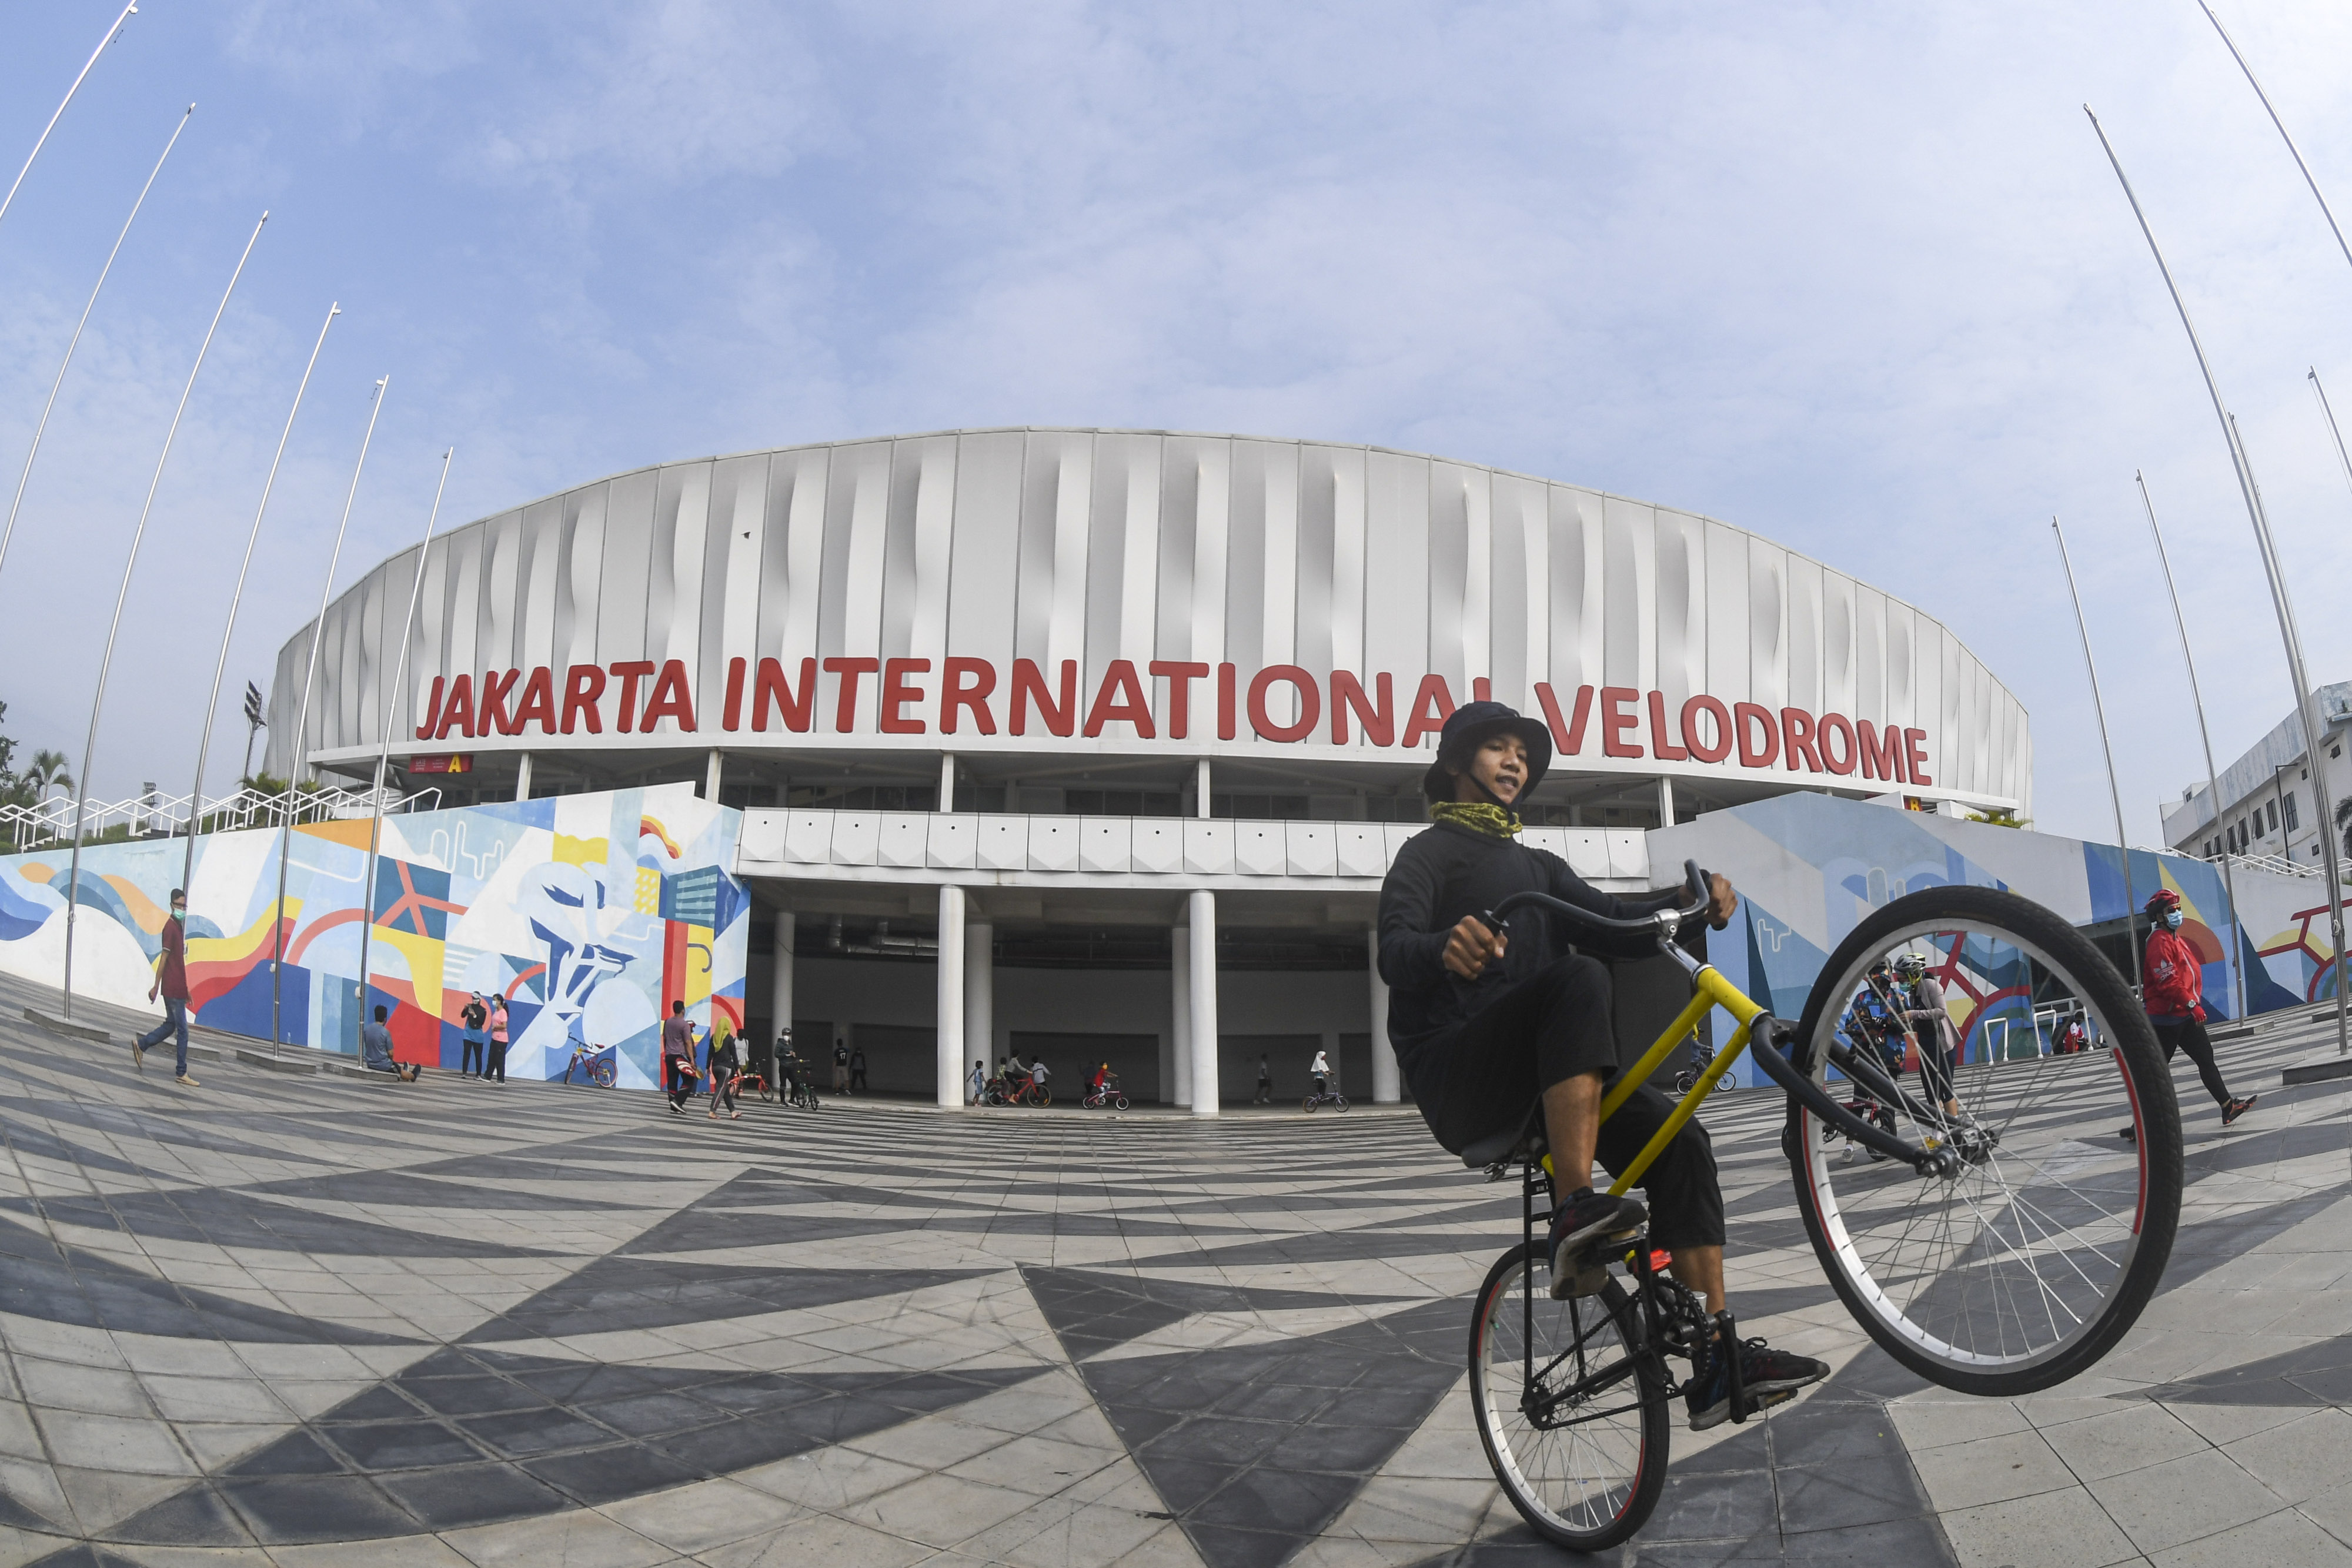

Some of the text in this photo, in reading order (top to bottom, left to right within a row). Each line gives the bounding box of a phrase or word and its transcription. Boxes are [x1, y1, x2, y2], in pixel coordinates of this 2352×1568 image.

[415, 659, 698, 740] JAKARTA
[1534, 682, 1933, 786] VELODROME
[448, 753, 462, 773] A
[1910, 797, 1920, 811] B
